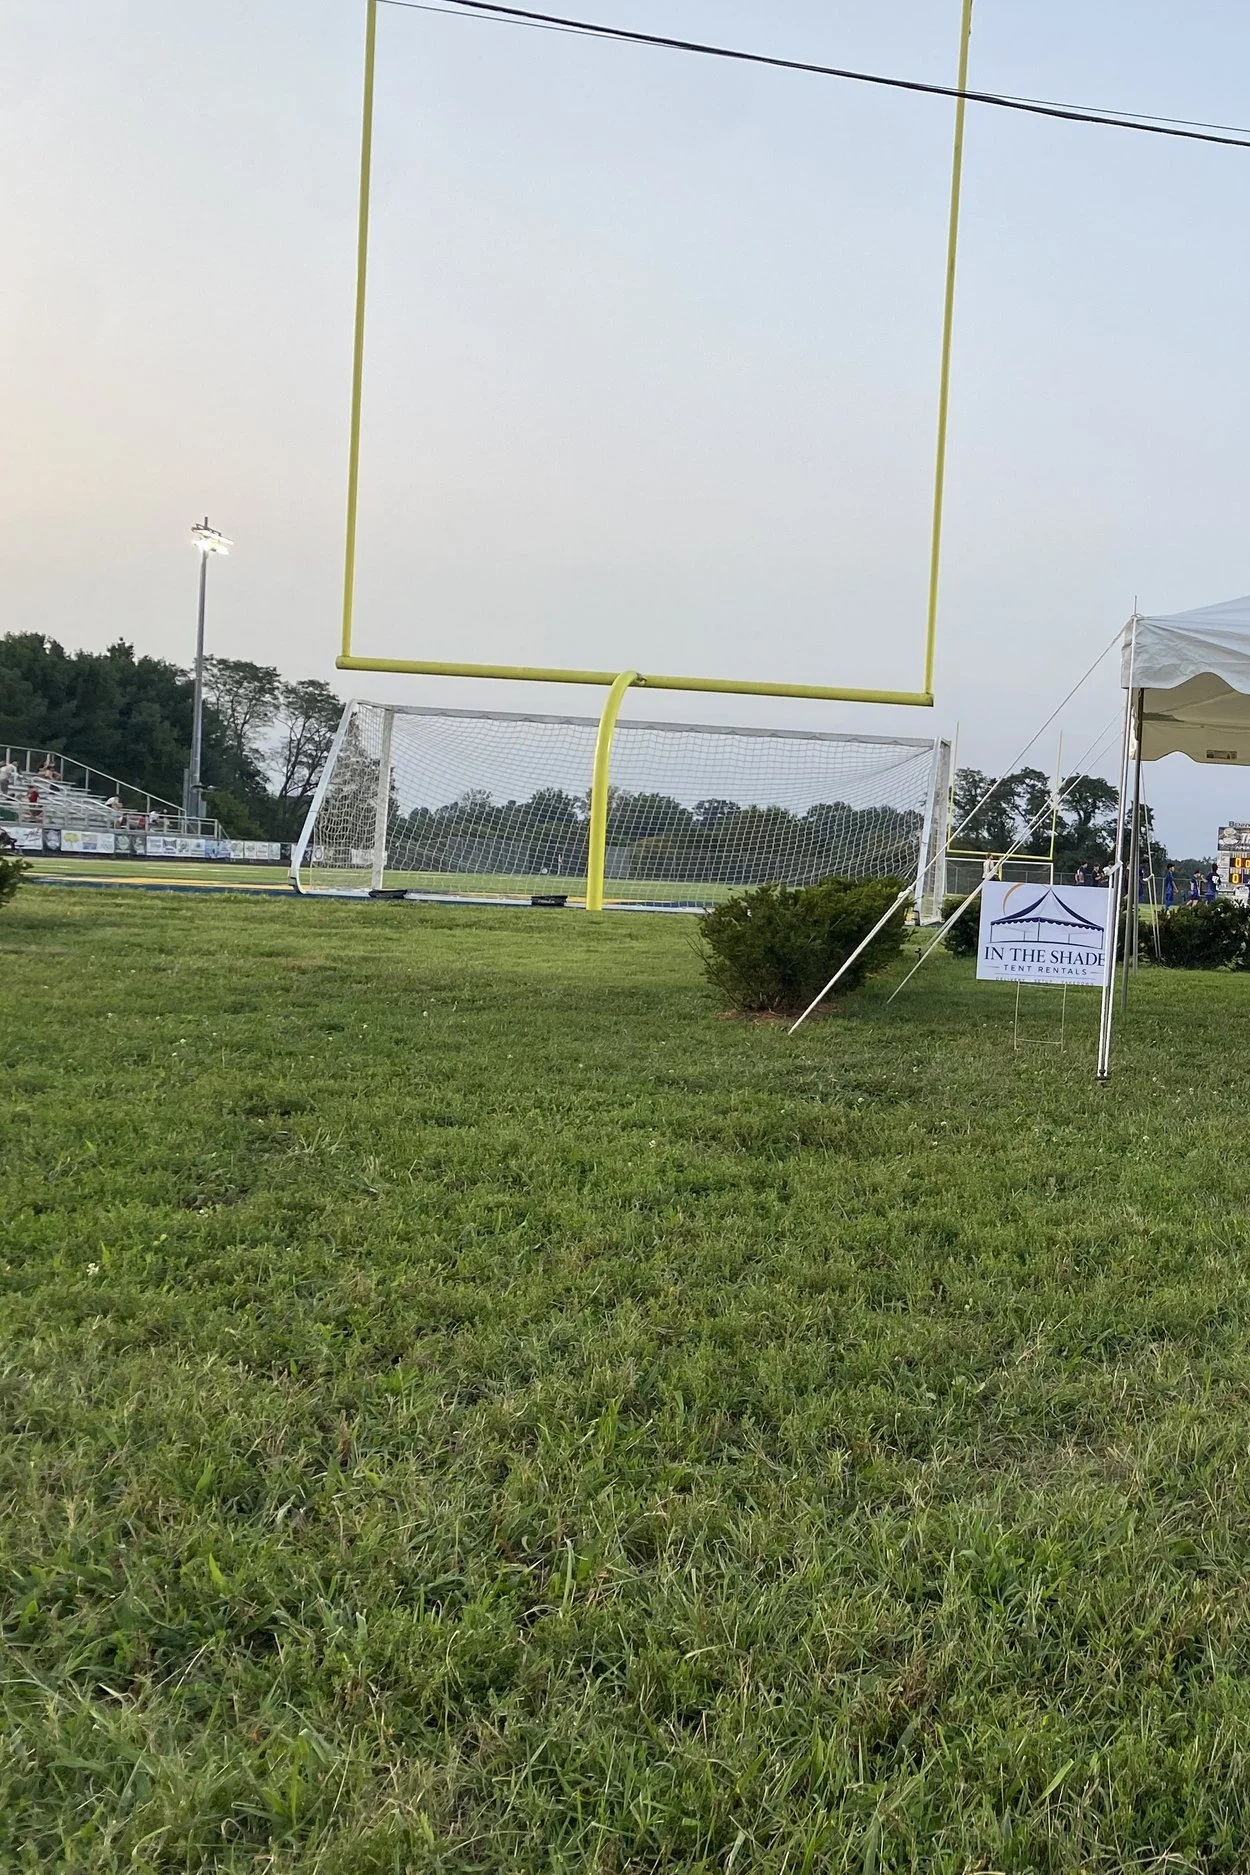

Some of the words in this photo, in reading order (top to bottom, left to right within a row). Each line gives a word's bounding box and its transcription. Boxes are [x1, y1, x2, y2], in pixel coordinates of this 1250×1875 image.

[984, 946, 1004, 961] IN
[1009, 948, 1045, 963] THE
[1050, 950, 1105, 967] SHADE
[1003, 964, 1032, 972] TENT
[1038, 966, 1087, 975] RENTALS
